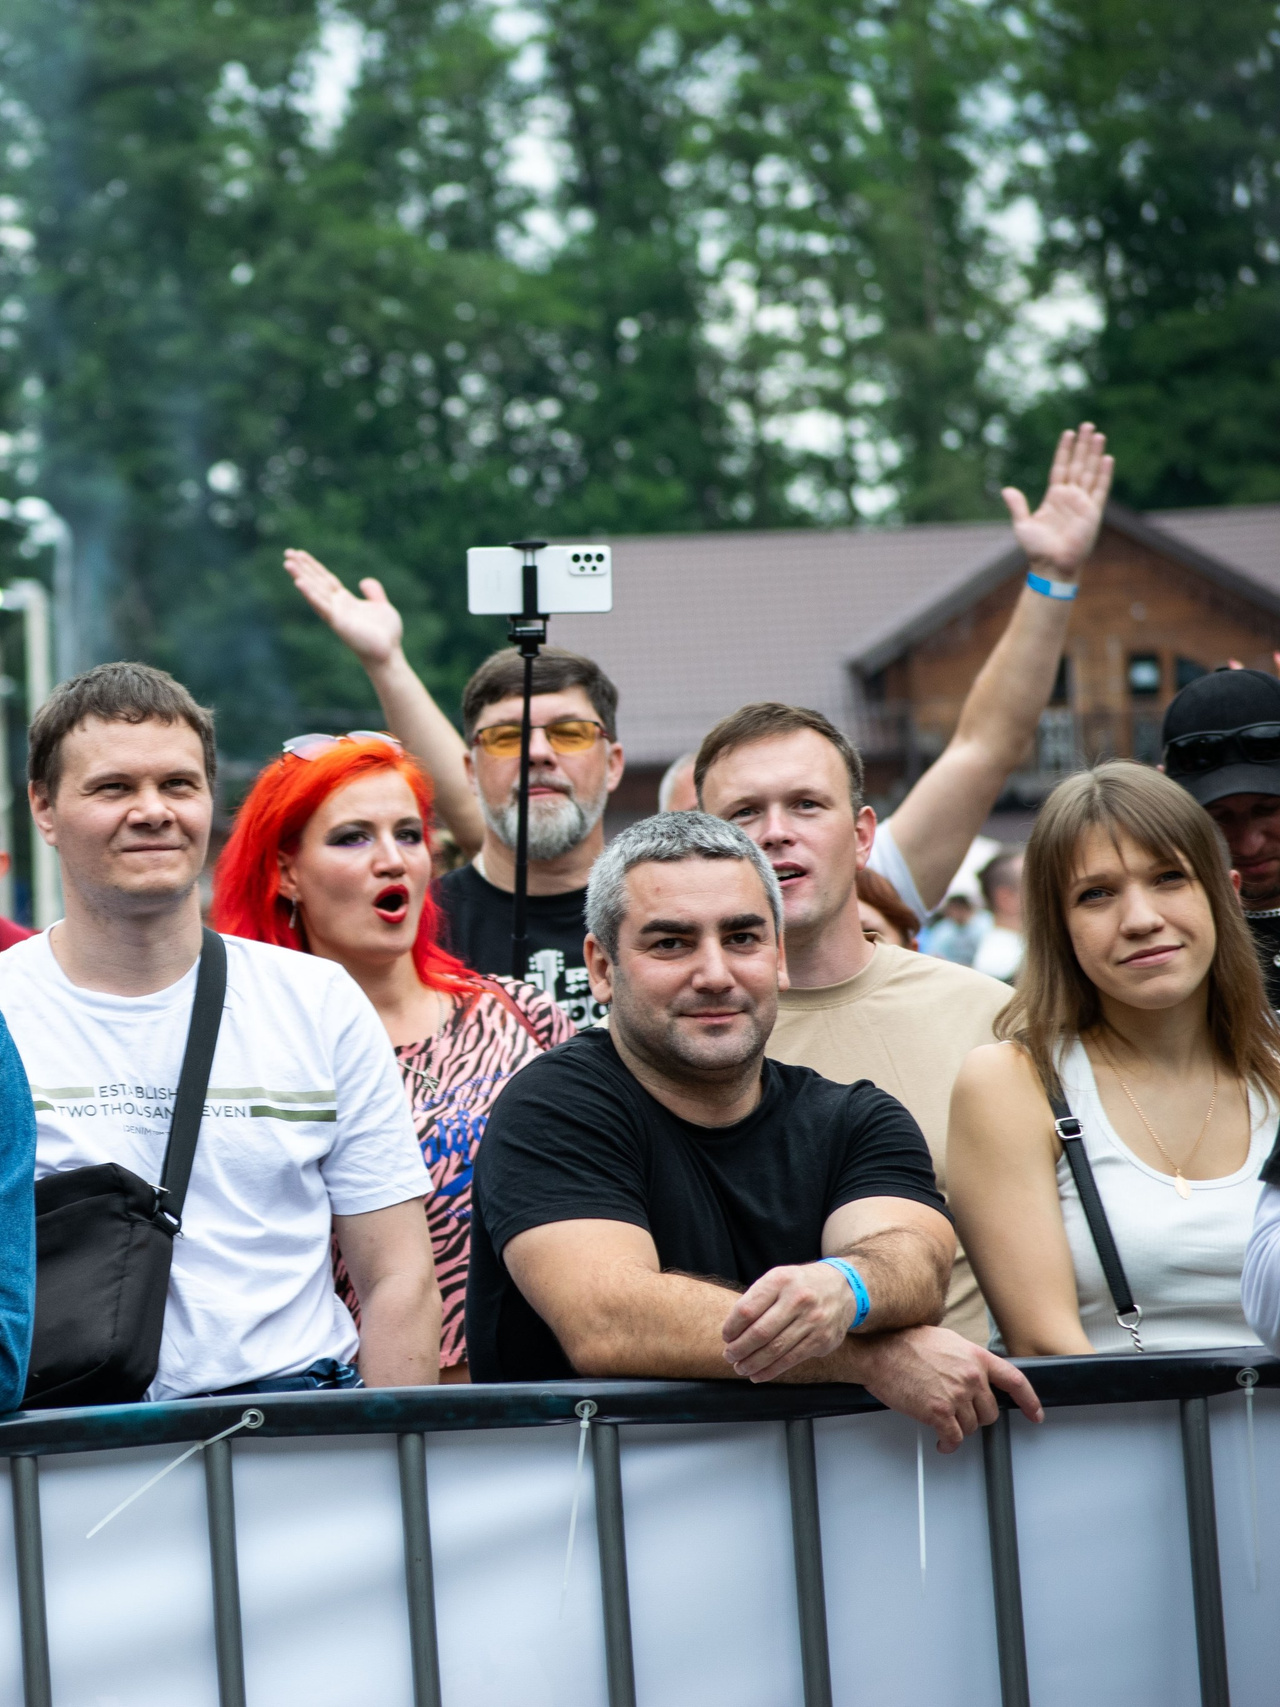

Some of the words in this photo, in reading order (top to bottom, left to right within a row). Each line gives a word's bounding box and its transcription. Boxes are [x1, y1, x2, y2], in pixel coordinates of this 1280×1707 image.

[100, 1083, 178, 1100] ESTABLISH
[57, 1104, 97, 1118] TWO
[100, 1102, 176, 1119] THOUSAN
[202, 1105, 246, 1117] EVEN
[420, 1110, 488, 1169] alifo
